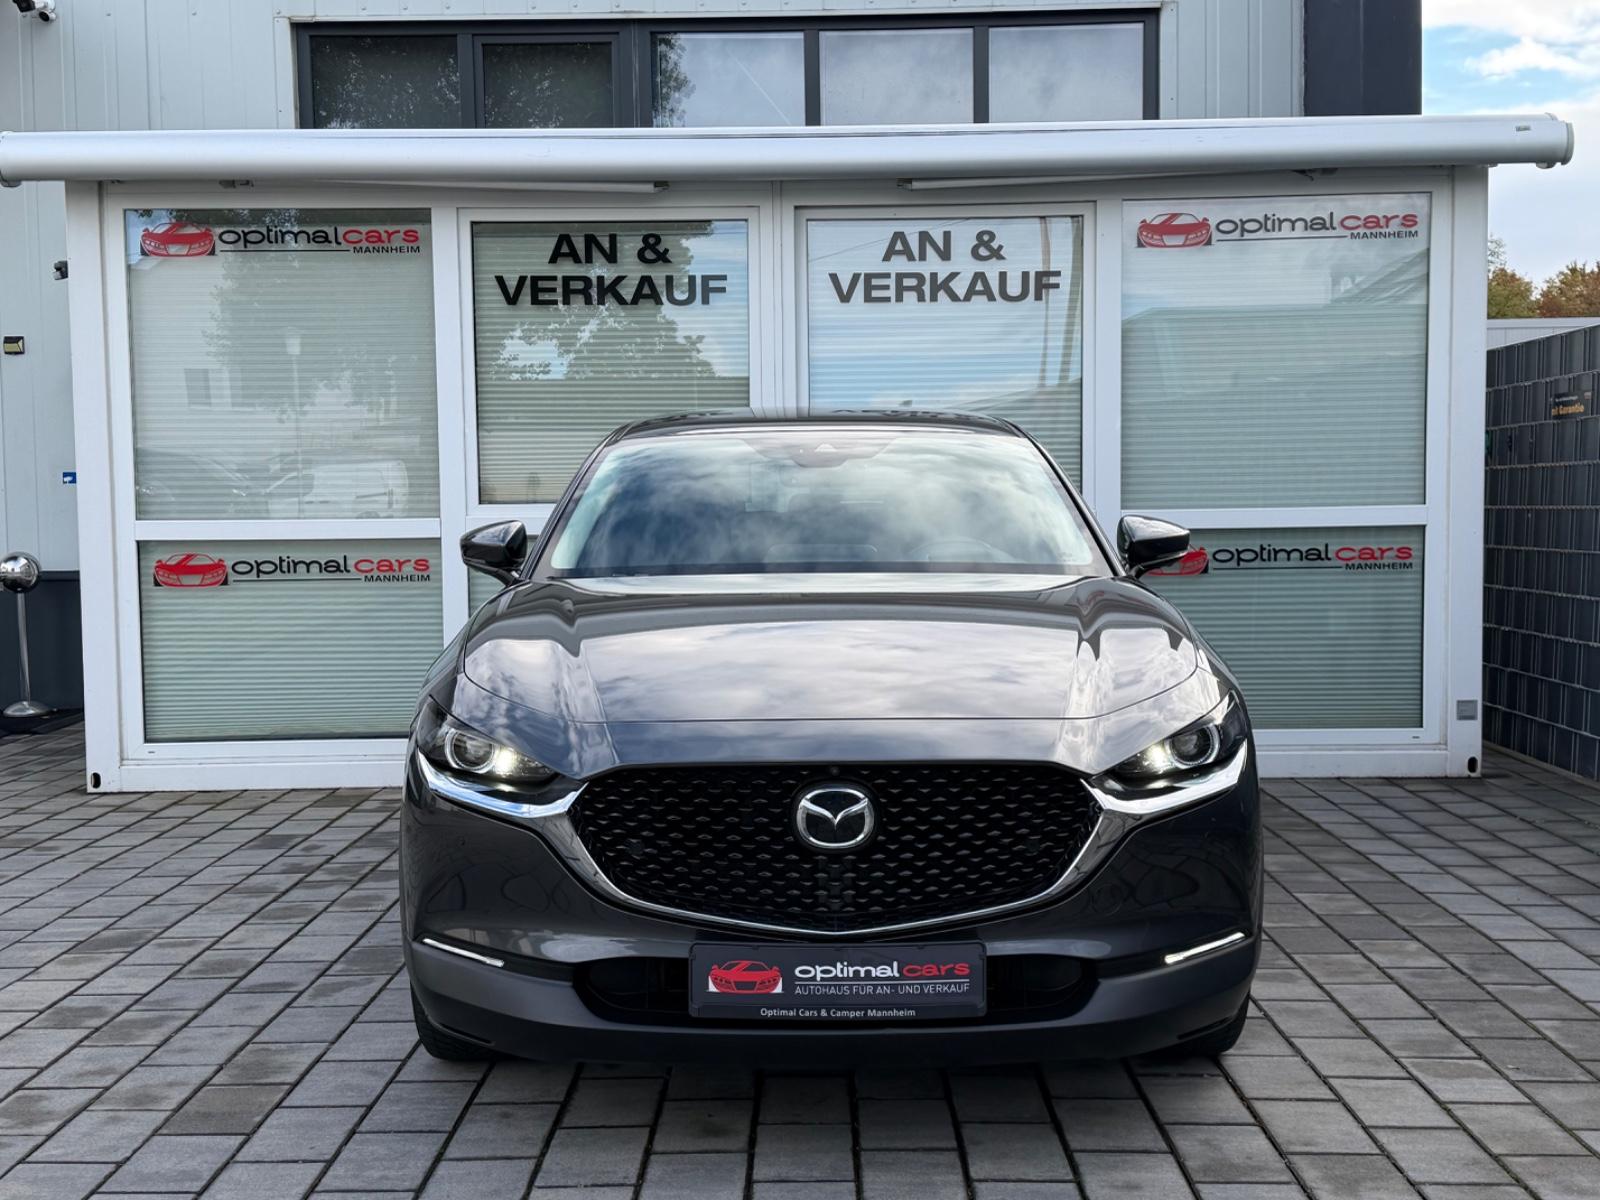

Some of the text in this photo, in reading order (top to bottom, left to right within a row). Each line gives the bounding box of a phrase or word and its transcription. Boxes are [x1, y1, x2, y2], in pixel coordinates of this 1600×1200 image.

[1338, 213, 1418, 230] cars
[1350, 230, 1418, 240] MANNHEIM
[352, 245, 420, 254] MANNHEIM
[548, 233, 672, 264] AN &
[881, 229, 1007, 262] AN &
[494, 274, 727, 306] VERKAUF
[828, 270, 1062, 304] VERKAUF
[1334, 546, 1413, 561] cars
[353, 558, 430, 573] cars
[1345, 562, 1413, 570] MANNHEIM
[364, 573, 431, 582] MANNHEIM
[794, 961, 970, 982] optimal cars
[794, 983, 970, 995] AUTOHAUS FÜR AN- UND VERKAUF
[760, 1007, 916, 1019] Optimal Cars & Camper Mannheim
